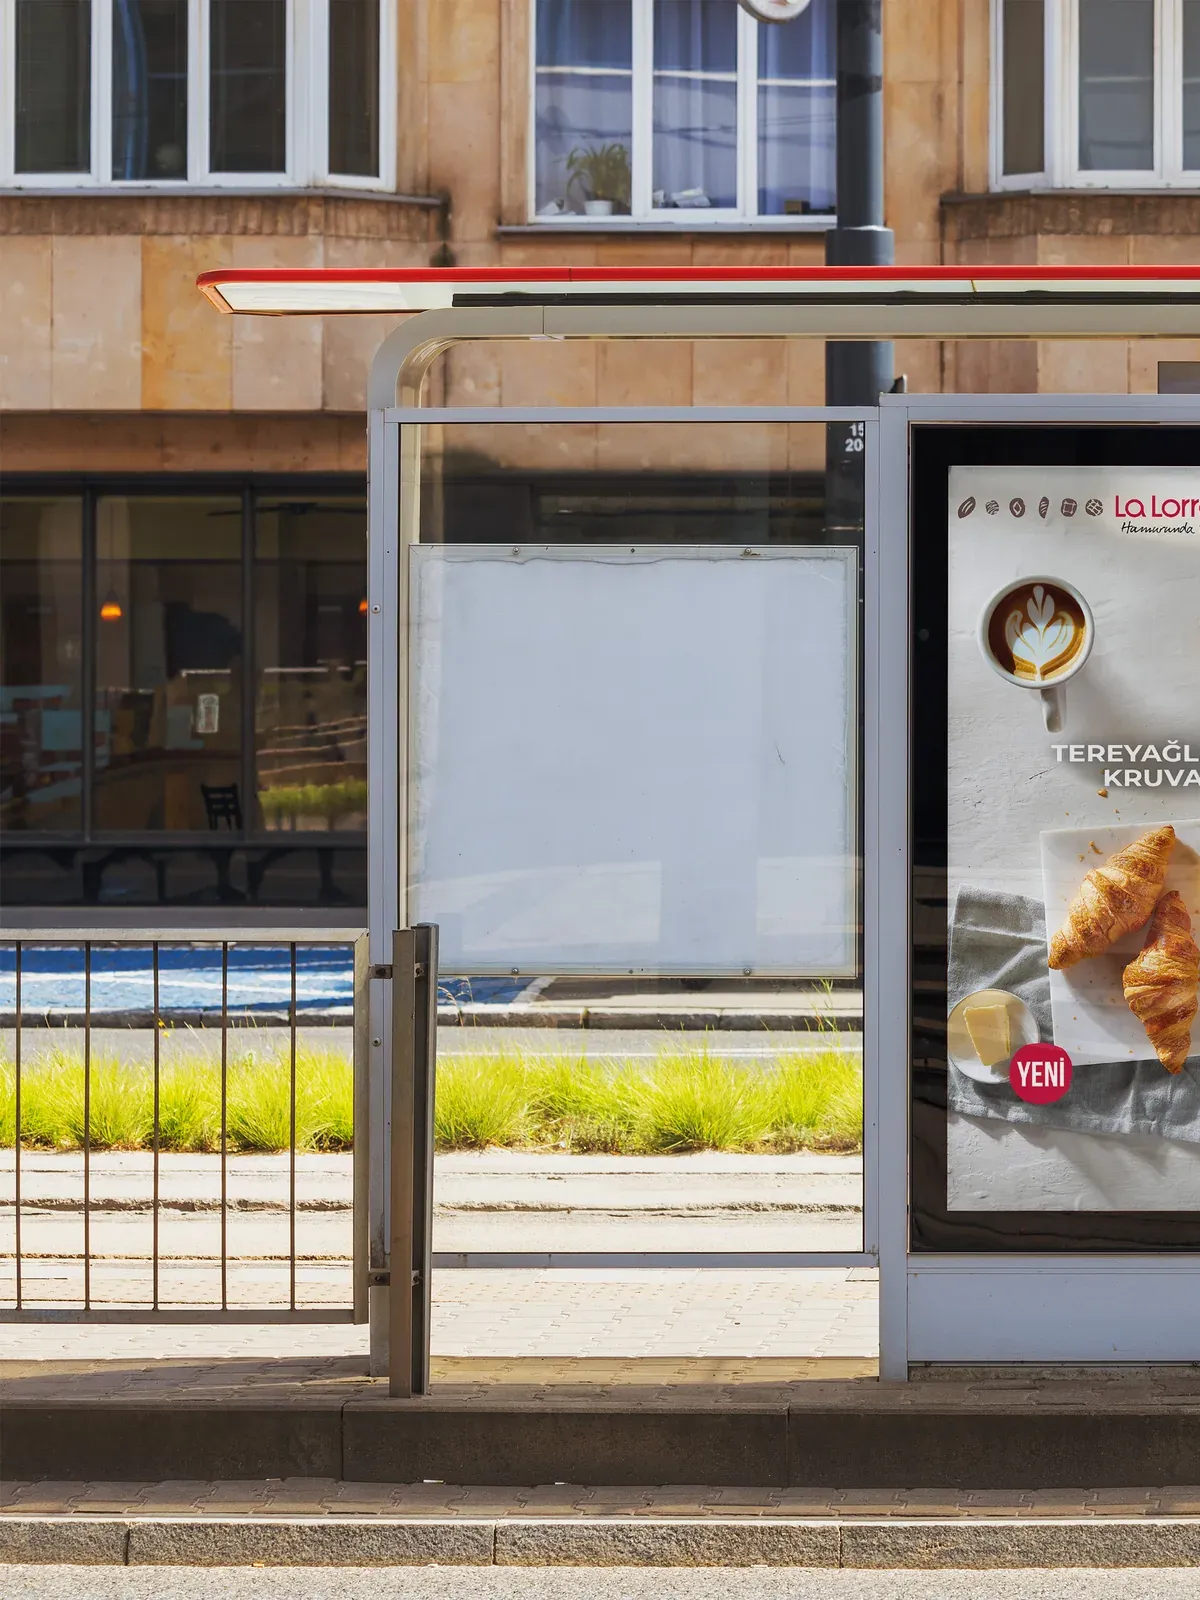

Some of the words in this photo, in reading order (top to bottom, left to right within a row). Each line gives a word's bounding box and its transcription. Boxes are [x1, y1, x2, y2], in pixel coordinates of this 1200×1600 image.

[1115, 495, 1146, 518] La
[1121, 520, 1195, 535] Hamurunda
[1017, 1057, 1065, 1087] YENİ
